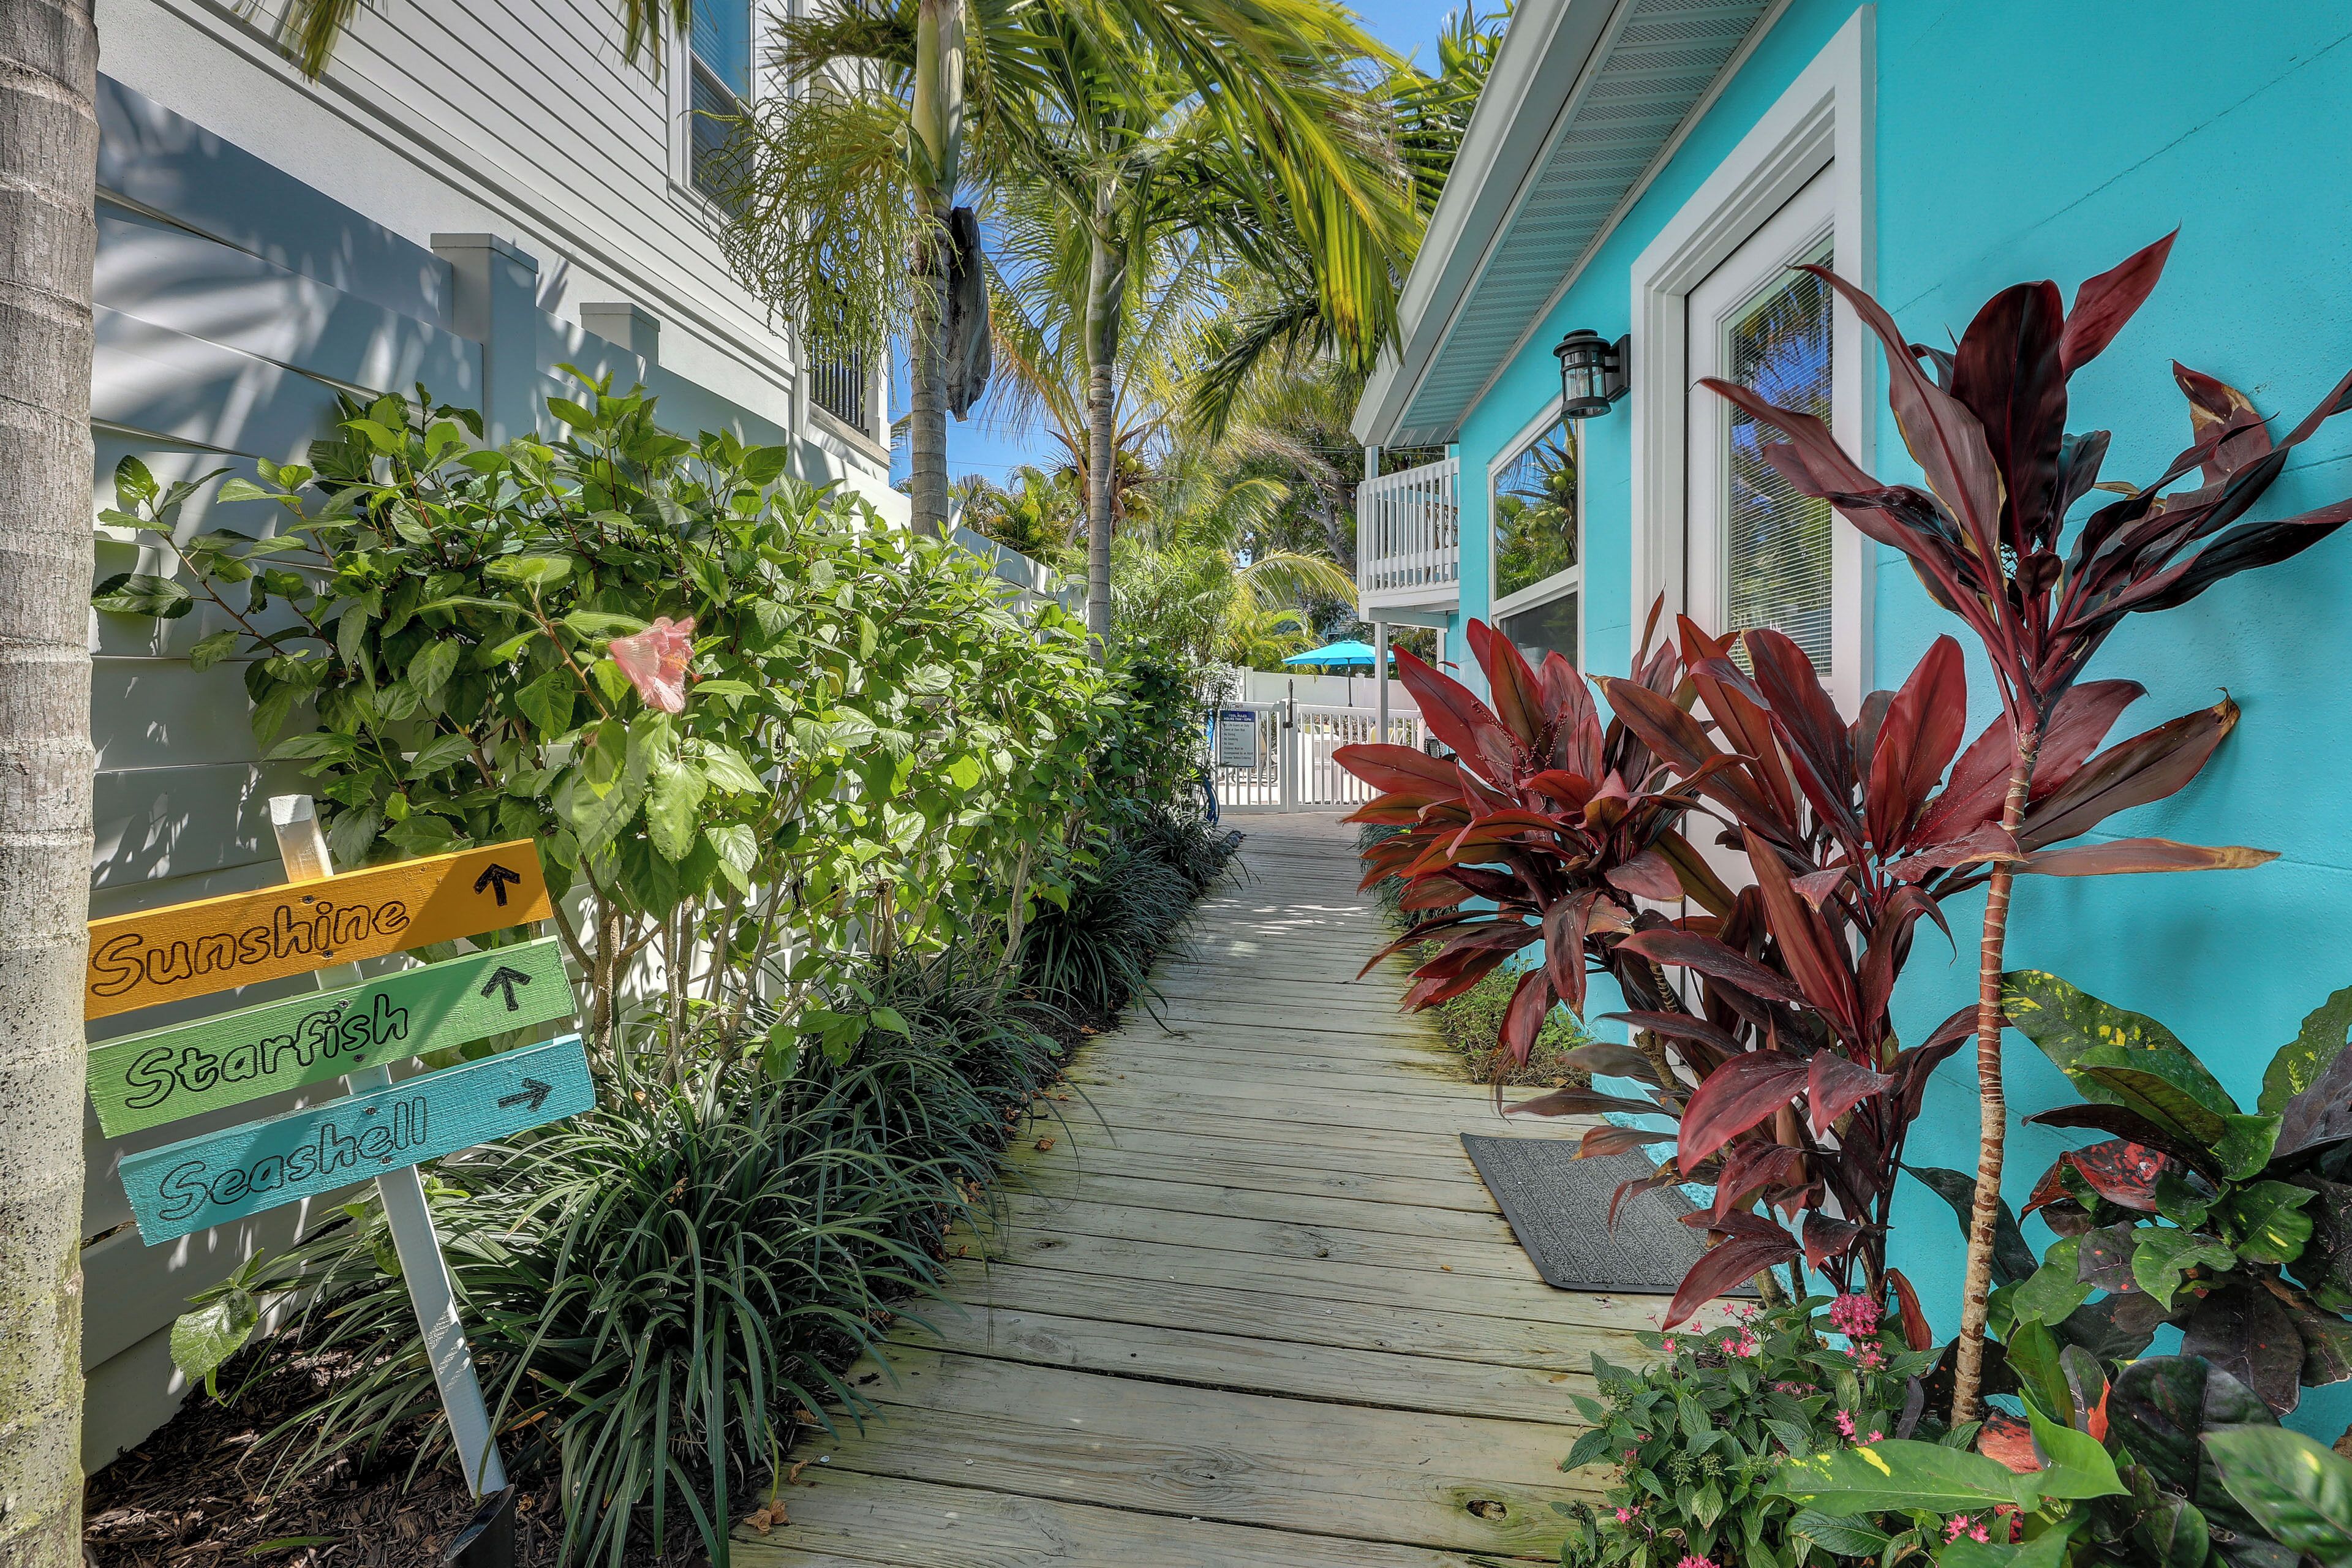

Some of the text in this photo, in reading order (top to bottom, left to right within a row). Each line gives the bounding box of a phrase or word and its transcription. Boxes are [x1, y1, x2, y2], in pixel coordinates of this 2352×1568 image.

[91, 900, 410, 997] Sunshine
[124, 993, 409, 1109] Starfish
[159, 1096, 427, 1221] Seashell
